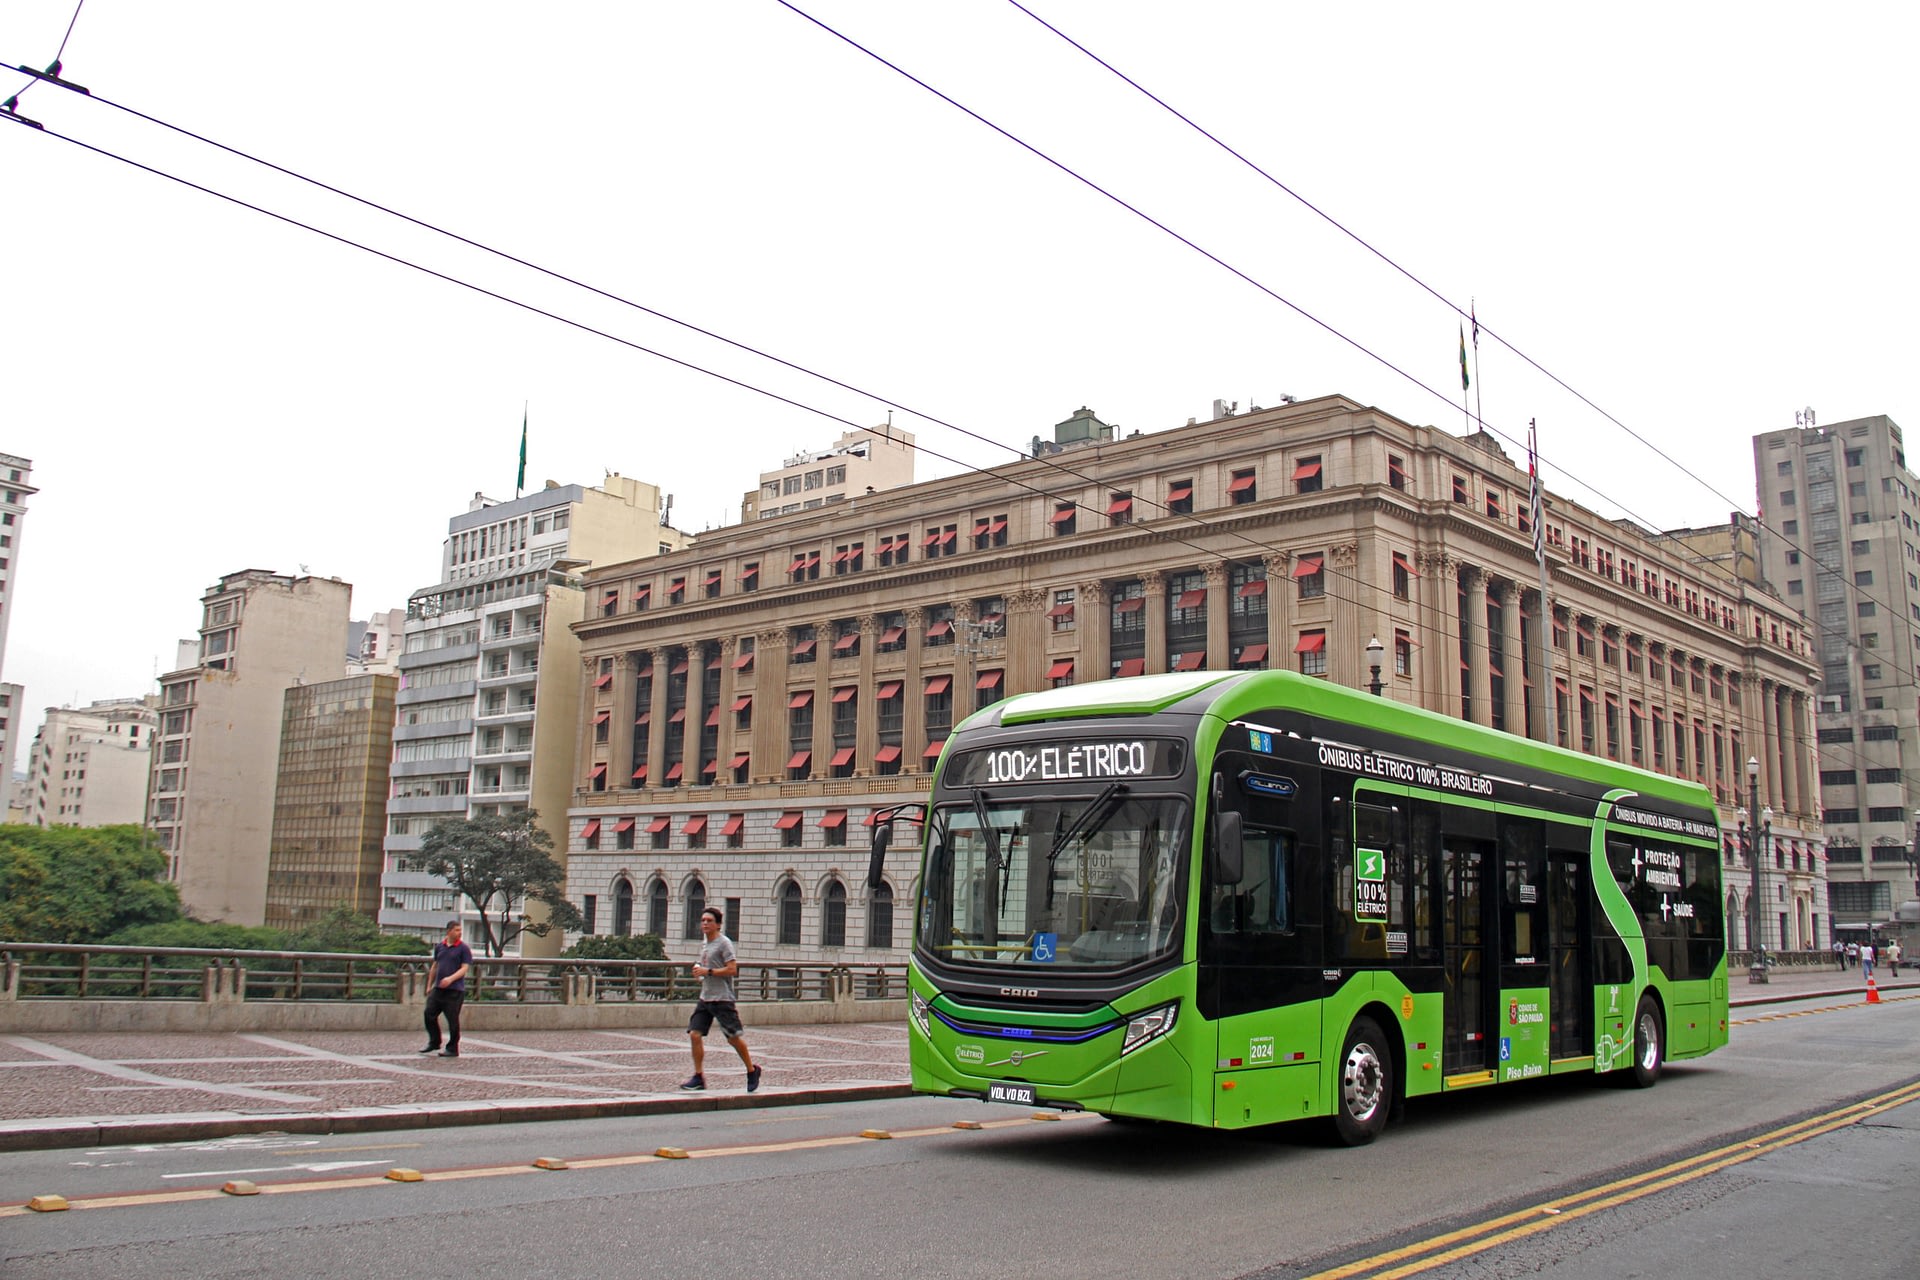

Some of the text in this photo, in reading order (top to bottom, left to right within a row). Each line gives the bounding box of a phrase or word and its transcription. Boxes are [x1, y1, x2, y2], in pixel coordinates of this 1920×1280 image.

[987, 741, 1145, 782] 100% ELÉTRICO
[1318, 742, 1493, 796] ÔNIBUS ELÉTRICO 100% BRASILEIRO
[1615, 804, 1637, 823] ÔNIBUS
[1637, 811, 1658, 827] MOVIDO
[1662, 816, 1684, 832] BATERIA
[1685, 821, 1693, 833] AR
[1692, 822, 1705, 836] MAIS
[1703, 825, 1718, 839] PURO
[1644, 849, 1680, 869] PROTEÇÃO
[1645, 869, 1681, 887] AMBIENTAL
[1357, 883, 1387, 901] 100%
[1357, 900, 1387, 914] ELÉTRICO
[1672, 901, 1694, 917] SAÚDE
[1518, 1012, 1543, 1024] SÃO PAULO
[1251, 1044, 1272, 1058] 2024
[1507, 1063, 1542, 1080] Piso Baixo
[1017, 1089, 1032, 1103] BZL
